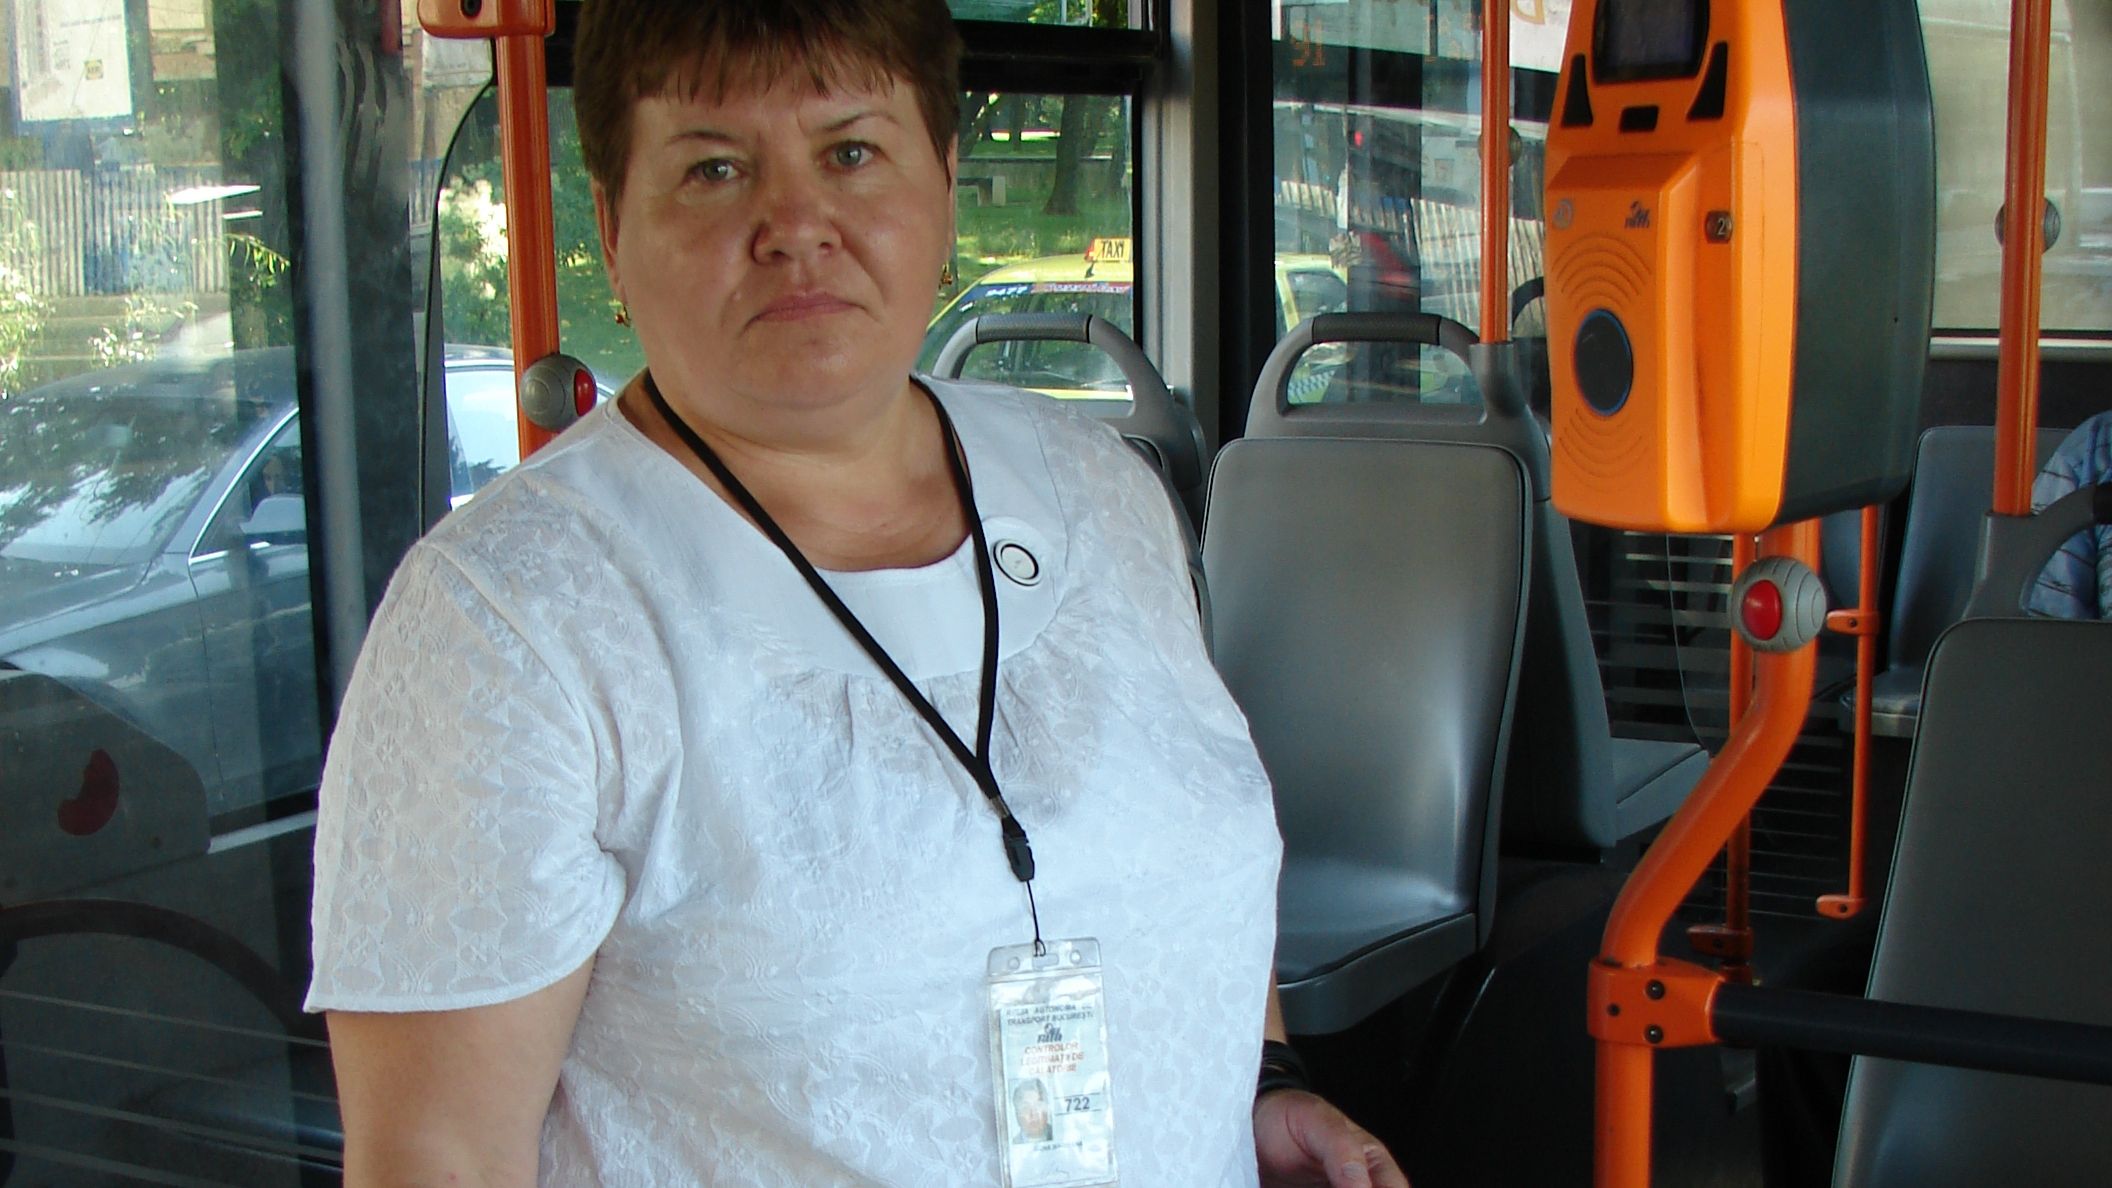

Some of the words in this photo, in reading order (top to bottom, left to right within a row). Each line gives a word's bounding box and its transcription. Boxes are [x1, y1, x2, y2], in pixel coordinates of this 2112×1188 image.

[1717, 218, 1726, 235] 2
[1101, 240, 1124, 258] TAXI
[1025, 1041, 1078, 1054] CONTROLOR
[1065, 1097, 1090, 1112] 722
